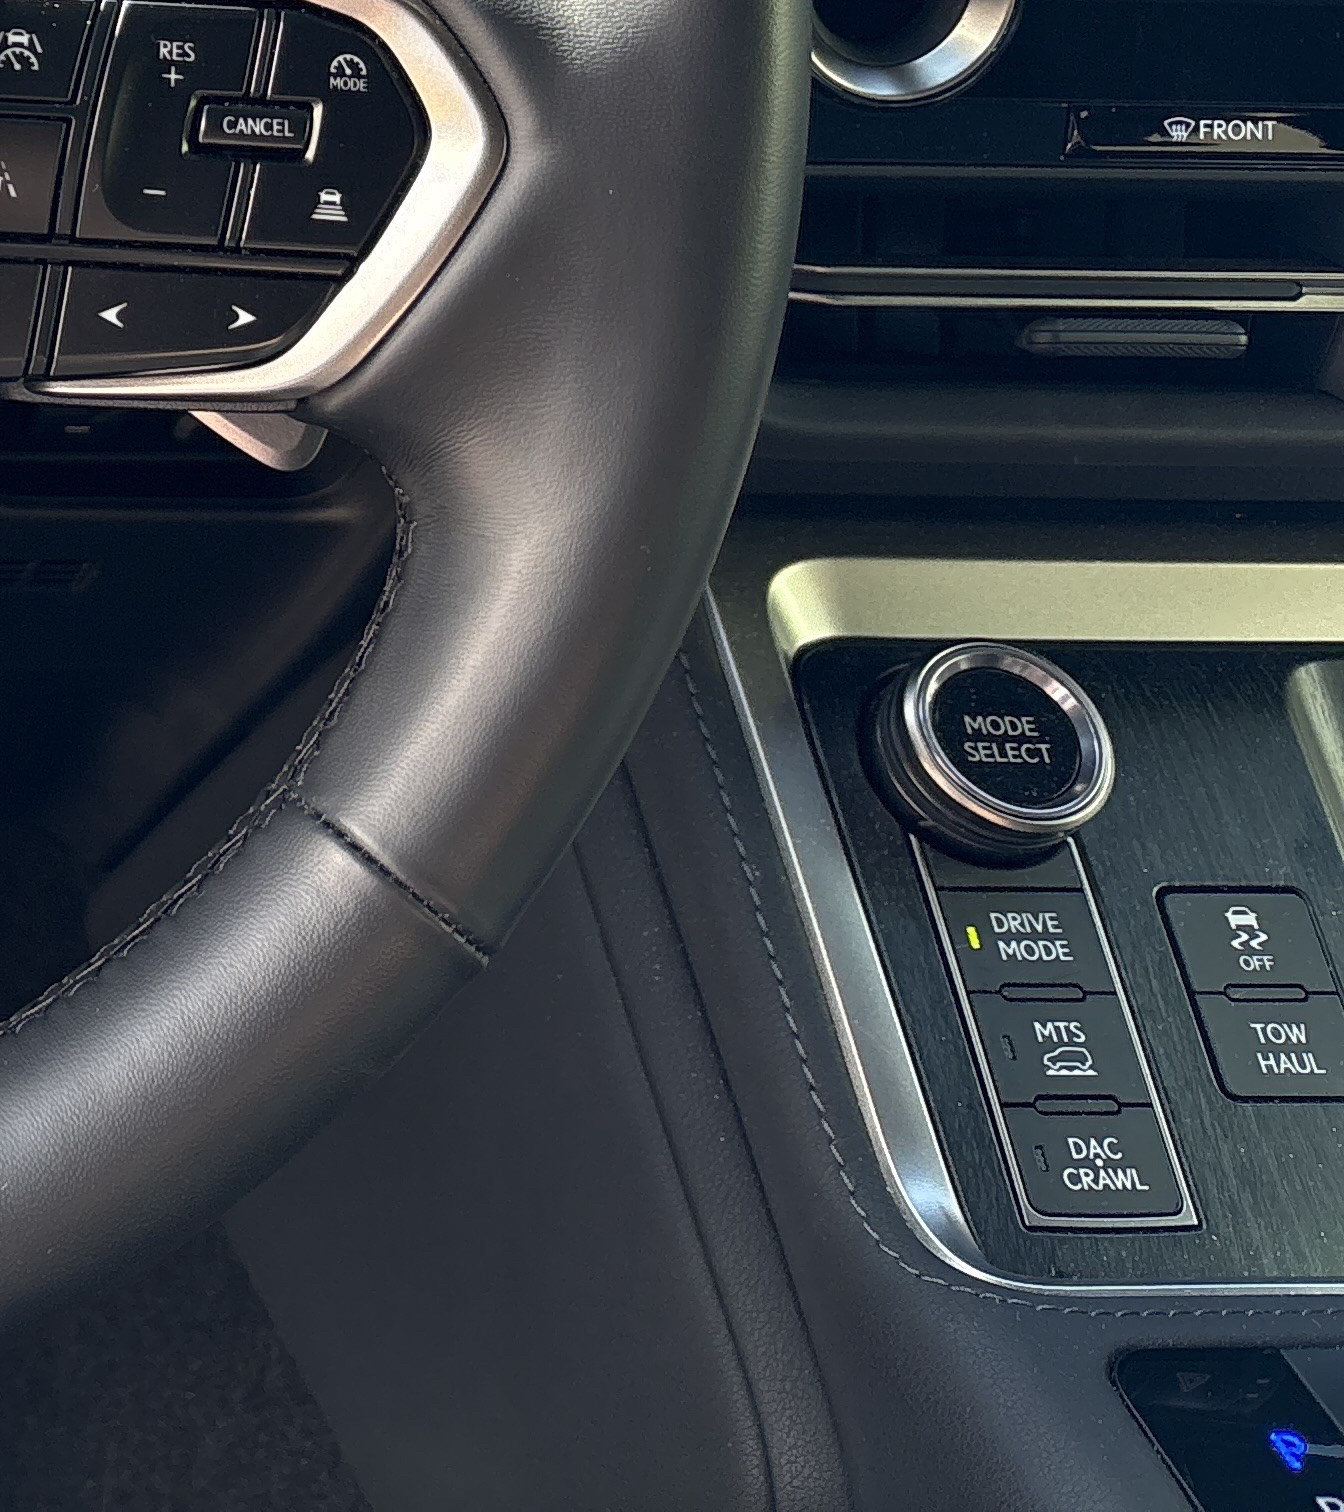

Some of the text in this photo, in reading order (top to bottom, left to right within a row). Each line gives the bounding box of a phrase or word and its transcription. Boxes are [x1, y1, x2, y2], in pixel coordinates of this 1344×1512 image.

[158, 39, 197, 64] RES
[328, 76, 369, 93] MODE
[222, 116, 295, 139] CANCEL
[1198, 119, 1278, 141] FRONT
[963, 713, 1040, 738] MODE
[963, 741, 1053, 766] SELECT
[989, 911, 1063, 935] DRIVE
[997, 939, 1074, 962] MODE
[1238, 954, 1275, 972] OFF
[1032, 1020, 1087, 1044] MTS
[1249, 1022, 1308, 1045] TOW
[1256, 1051, 1328, 1076] HAUL
[1066, 1136, 1123, 1161] DAC
[1062, 1167, 1150, 1192] CRAWL
